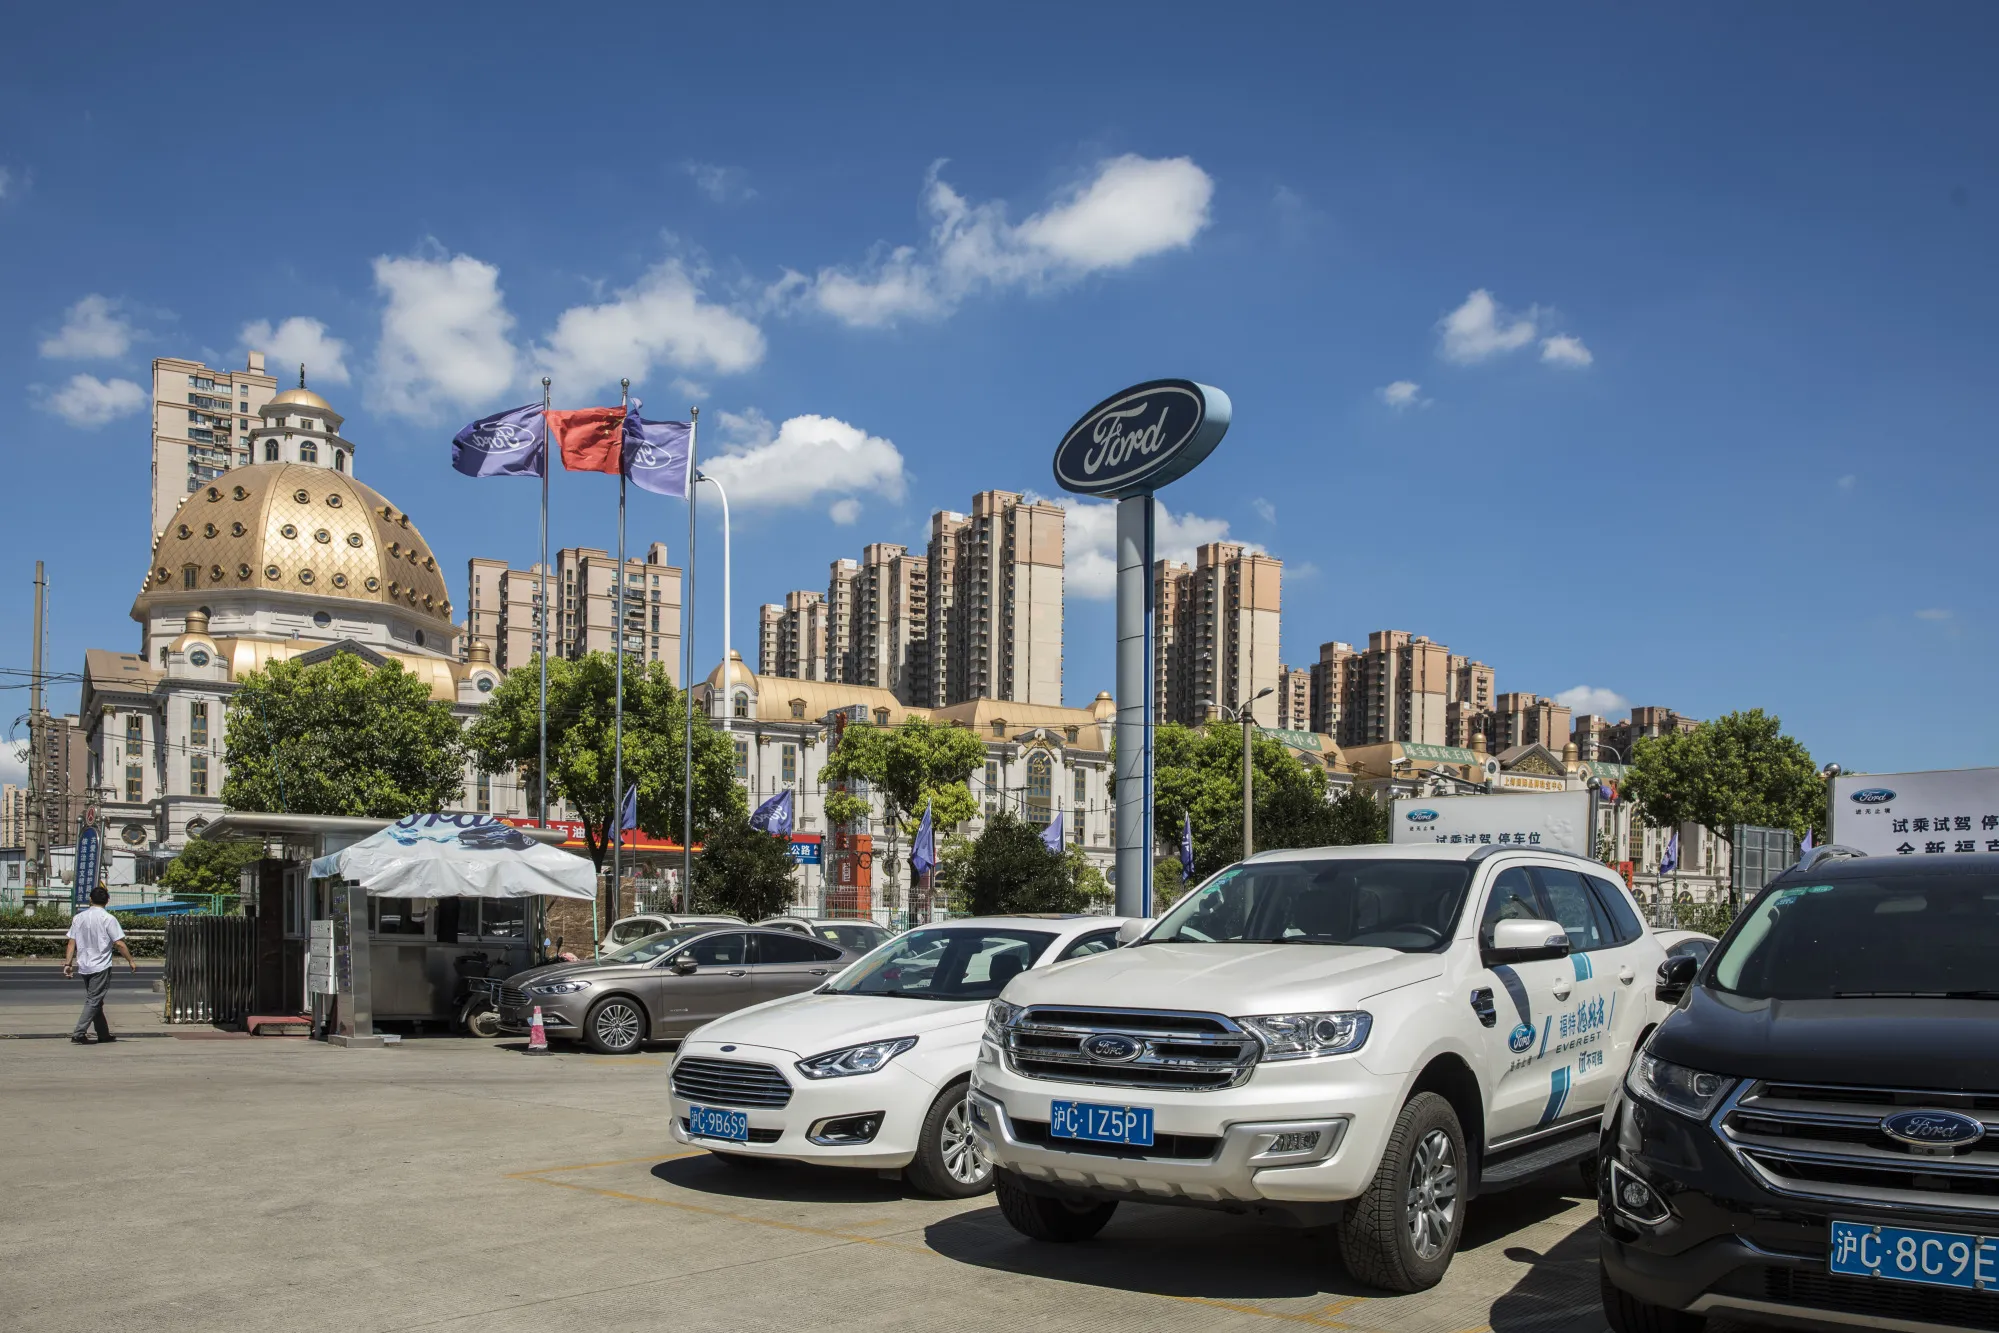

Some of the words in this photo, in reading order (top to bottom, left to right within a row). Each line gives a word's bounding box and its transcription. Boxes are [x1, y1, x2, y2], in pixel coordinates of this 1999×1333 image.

[1083, 401, 1169, 475] Ford
[1860, 791, 1887, 802] Ford
[1893, 816, 1972, 833] 试乘试驾
[1436, 833, 1491, 844] 试乘试驾
[1498, 831, 1541, 845] 停车位
[1095, 1040, 1125, 1058] Ford
[1556, 1031, 1602, 1054] EVEREST
[1905, 1116, 1958, 1138] Ford
